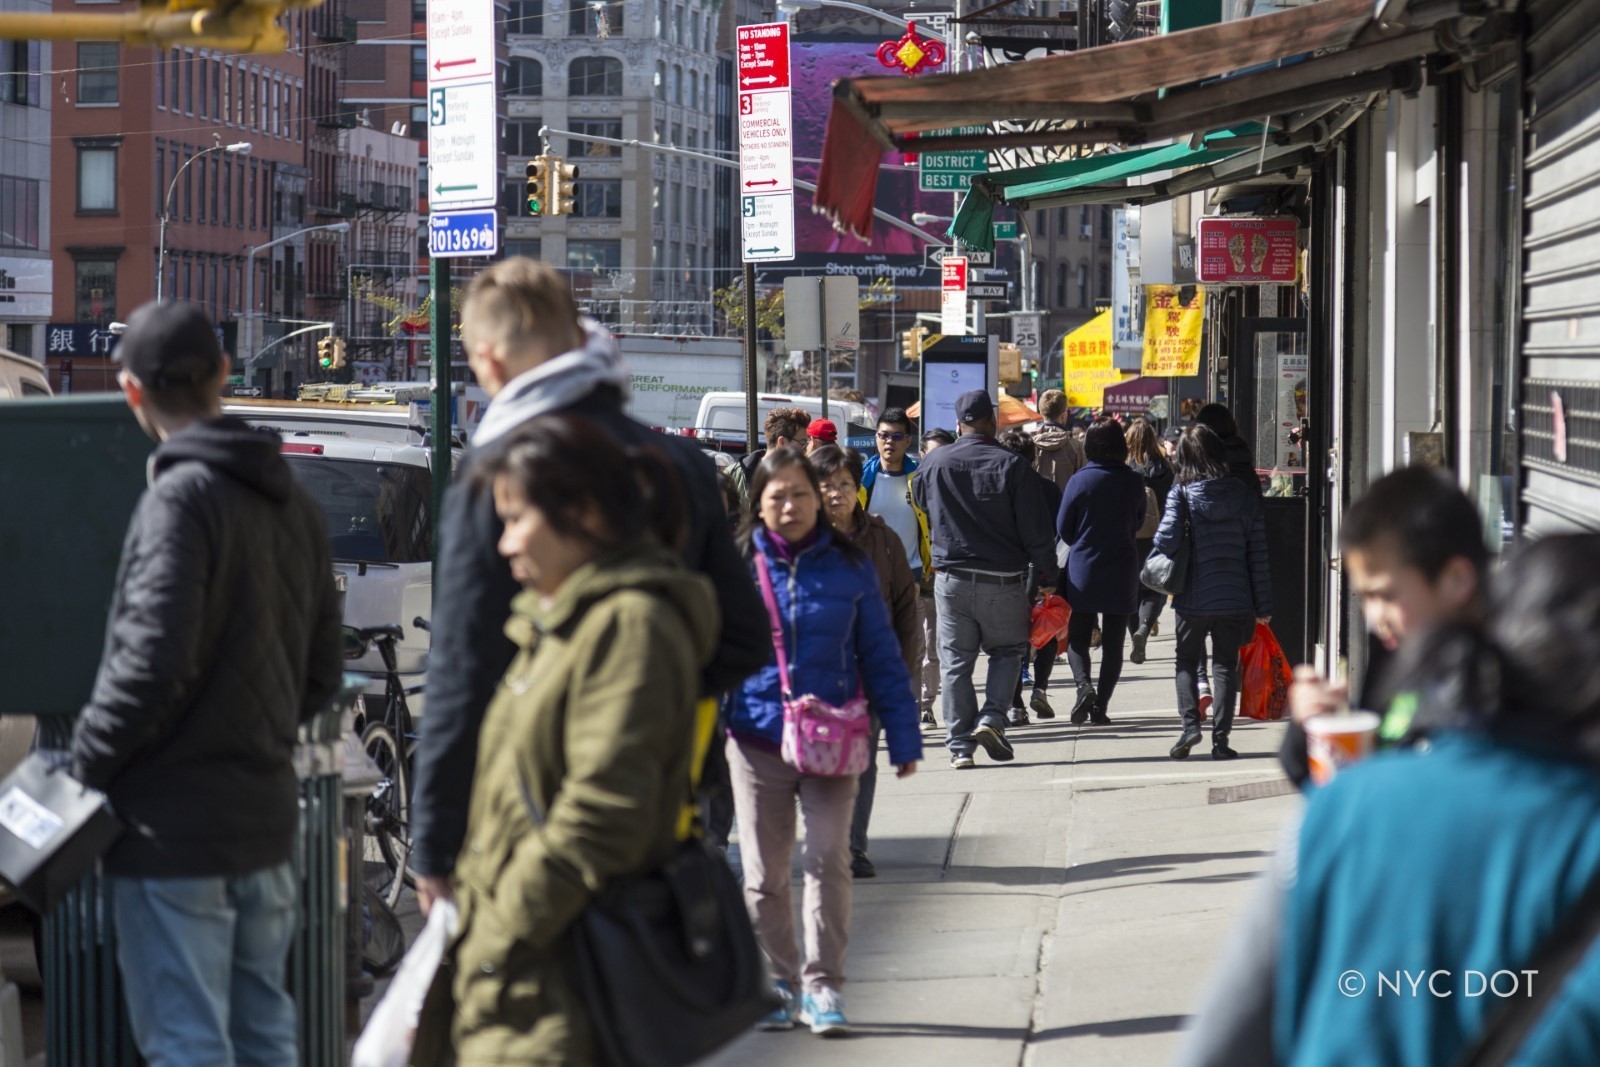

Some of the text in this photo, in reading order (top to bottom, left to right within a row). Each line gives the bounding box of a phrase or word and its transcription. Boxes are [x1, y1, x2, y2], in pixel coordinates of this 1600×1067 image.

[432, 24, 472, 39] Except Sunday
[740, 28, 780, 40] NO STANDING
[757, 59, 774, 67] Sunday
[432, 92, 443, 124] 5
[742, 96, 750, 113] 3
[743, 118, 780, 128] COMMERCIAL
[743, 128, 786, 138] VEHICLES ONLY
[960, 126, 986, 136] DRIV
[451, 134, 475, 146] Midnight
[433, 150, 474, 163] Except Sunday
[926, 156, 976, 168] DISTRICT
[926, 175, 953, 186] BEST
[744, 198, 753, 216] 5
[746, 222, 755, 230] 7pm
[433, 228, 478, 251] 101369
[826, 262, 854, 275] Shot
[875, 264, 917, 276] iPhone
[918, 265, 926, 276] 7
[50, 328, 112, 352] 銀行
[1016, 334, 1037, 346] 25
[632, 384, 728, 393] PERFORMANCES
